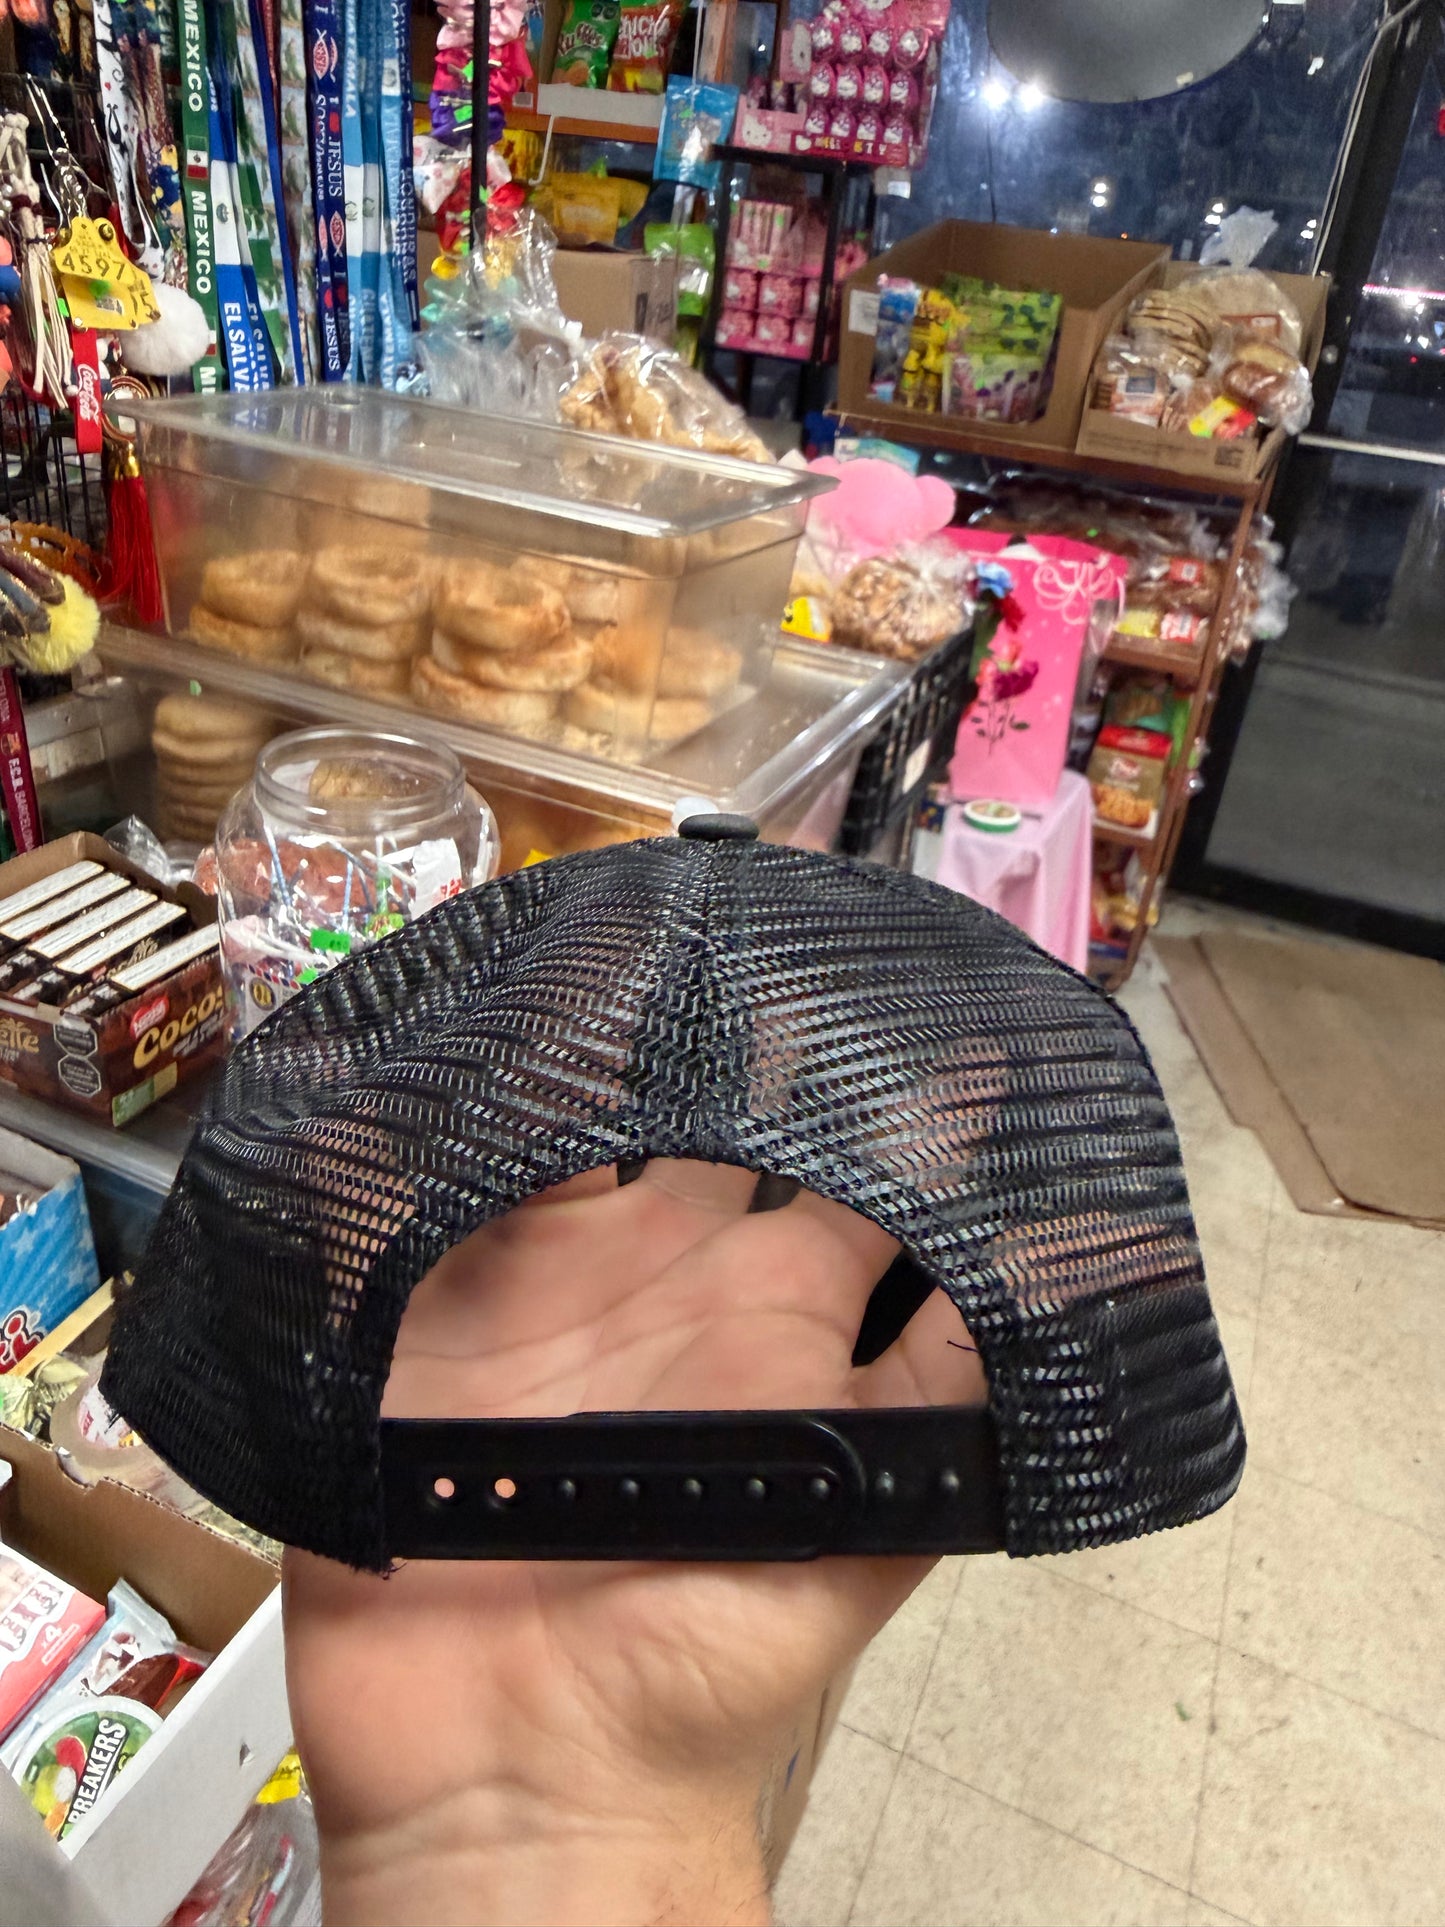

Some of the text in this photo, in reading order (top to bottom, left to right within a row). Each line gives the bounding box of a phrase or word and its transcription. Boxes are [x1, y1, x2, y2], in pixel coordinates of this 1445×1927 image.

[183, 0, 203, 112] MEXICO
[62, 252, 125, 281] 4597
[191, 190, 211, 294] MEXICO
[224, 303, 242, 327] EL
[324, 312, 340, 371] JESUS
